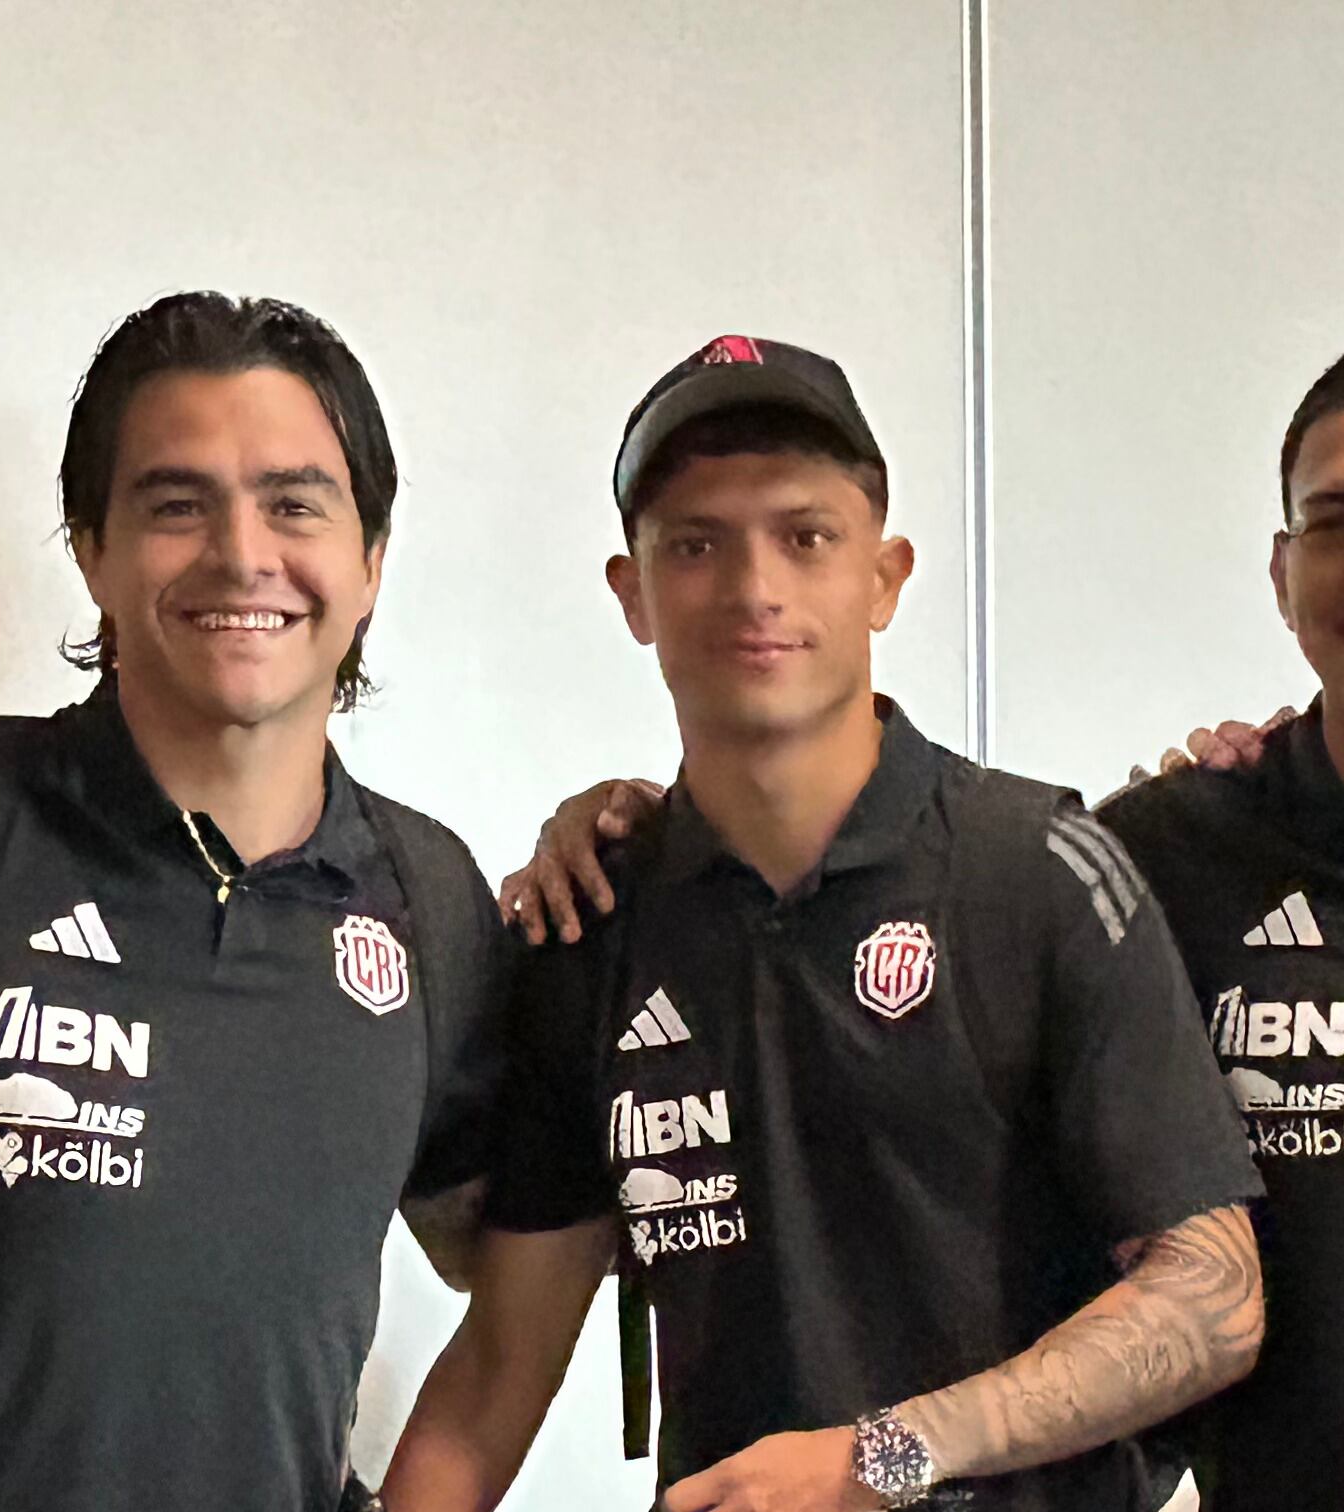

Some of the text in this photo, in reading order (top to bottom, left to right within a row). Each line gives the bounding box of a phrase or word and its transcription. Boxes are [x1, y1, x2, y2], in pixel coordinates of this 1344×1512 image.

[38, 1005, 150, 1078] BN
[76, 1100, 146, 1134] INS
[642, 1089, 732, 1155] BN
[684, 1174, 738, 1204] INS
